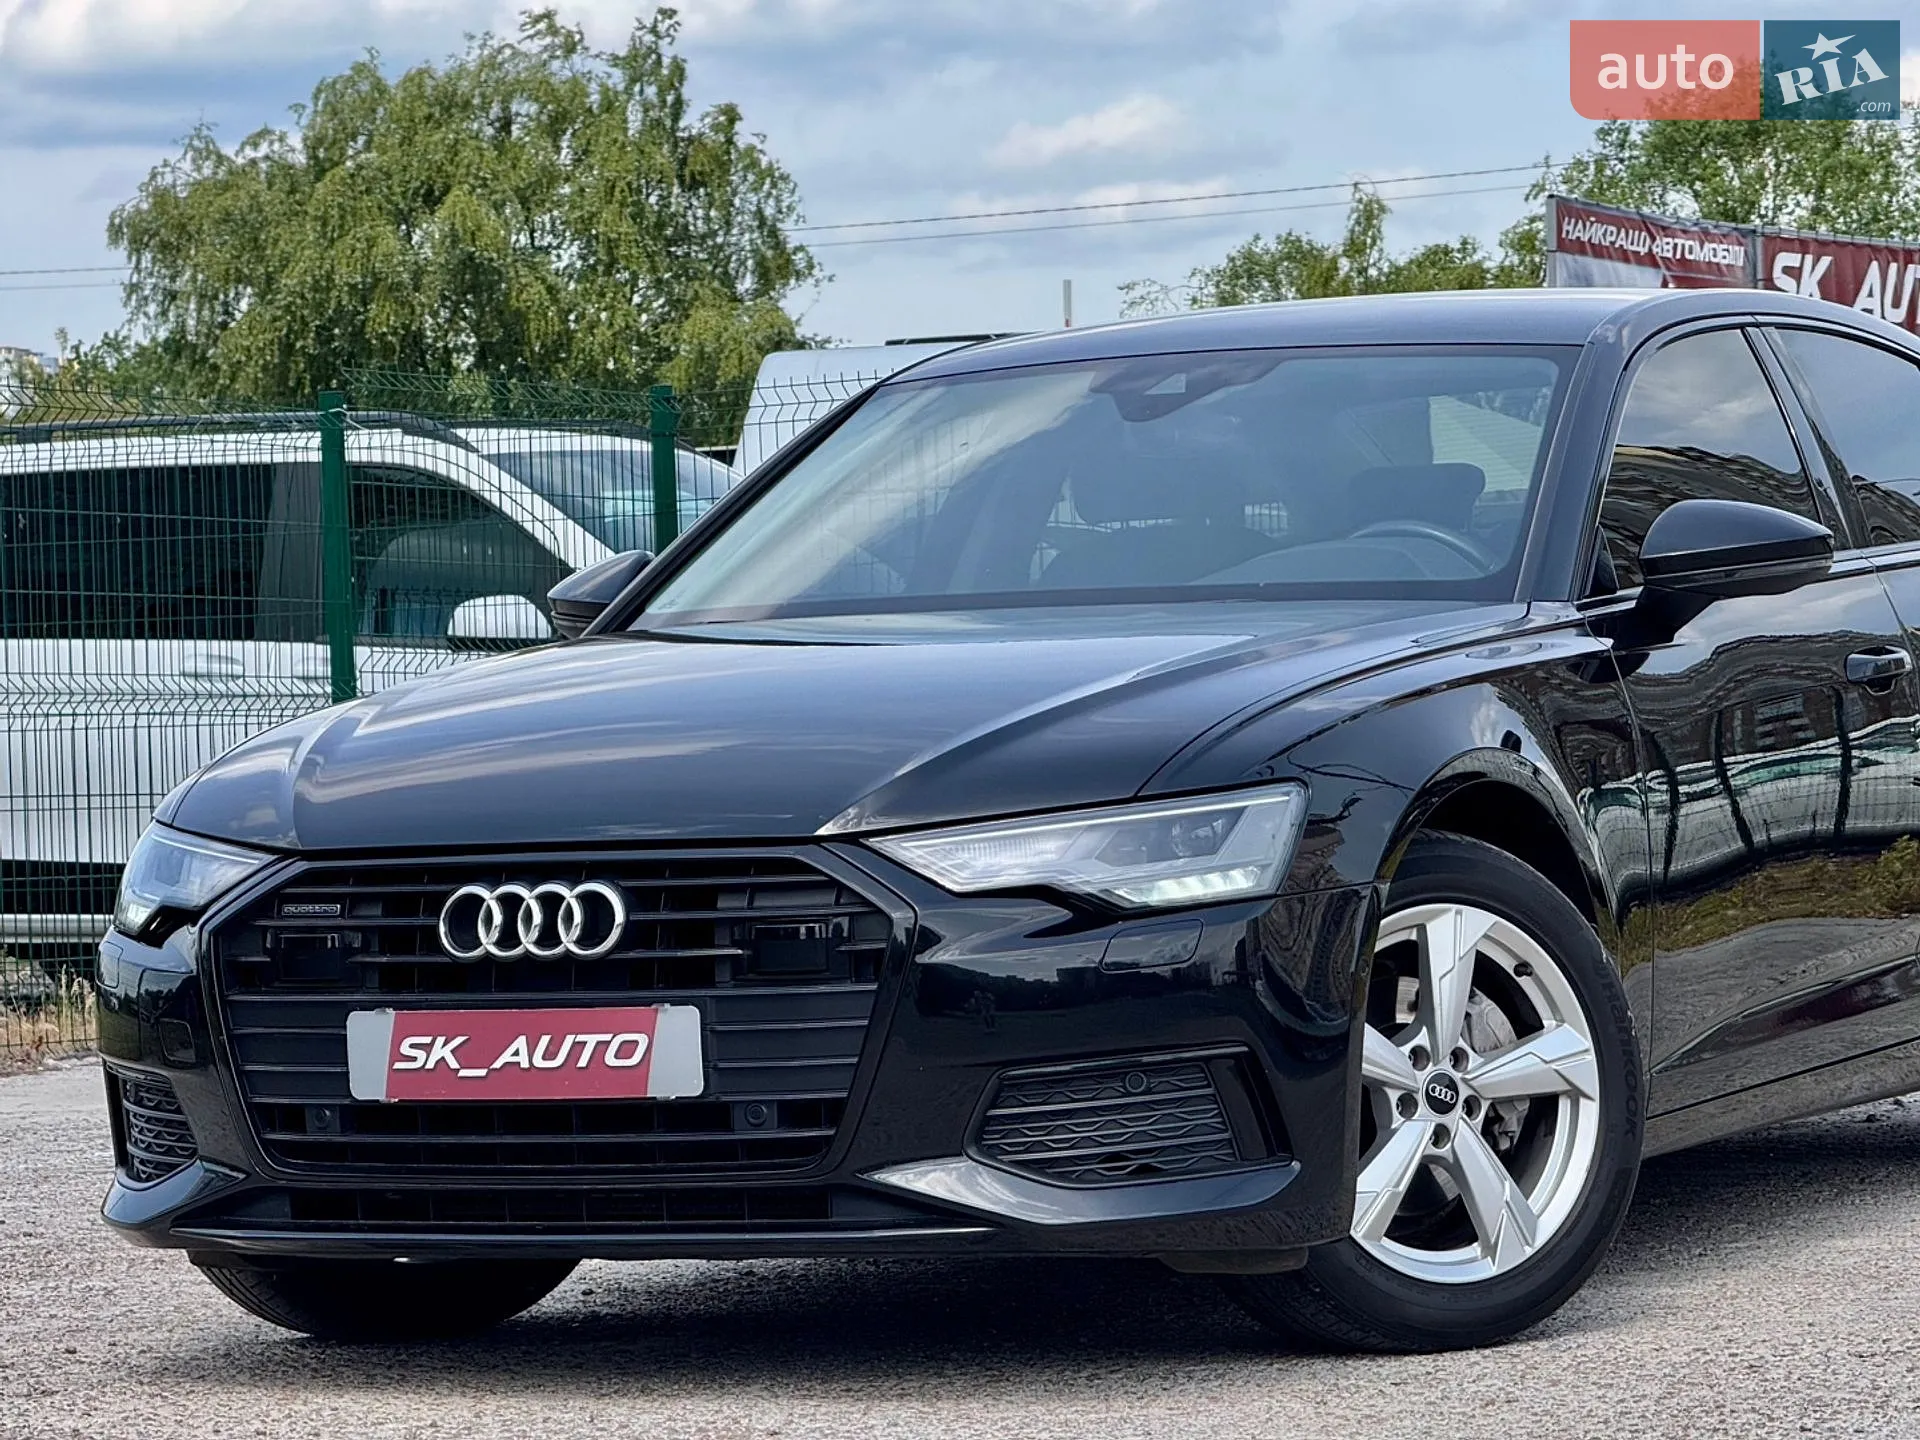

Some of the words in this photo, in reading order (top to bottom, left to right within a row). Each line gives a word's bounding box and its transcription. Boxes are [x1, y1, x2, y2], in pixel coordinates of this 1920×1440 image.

[1852, 260, 1920, 324] AU
[284, 906, 337, 915] quattro
[392, 1033, 649, 1078] SK_AUTO
